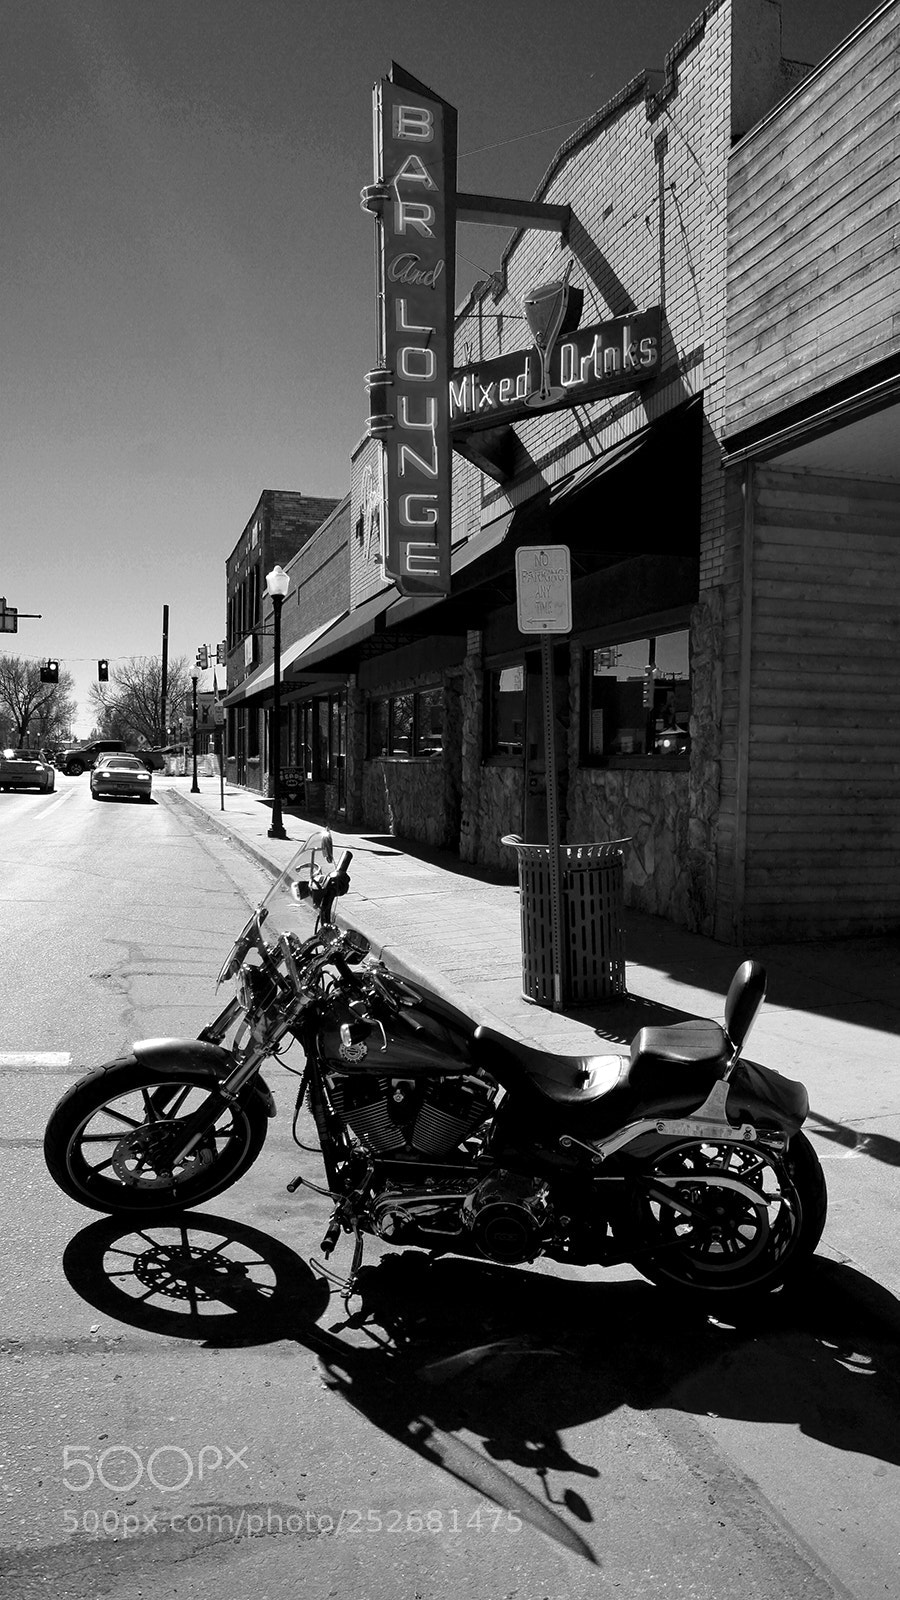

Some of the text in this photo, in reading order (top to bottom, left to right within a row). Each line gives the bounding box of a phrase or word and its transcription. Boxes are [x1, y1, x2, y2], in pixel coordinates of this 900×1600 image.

[392, 104, 440, 239] BAR
[449, 325, 657, 419] Mixed Drinks
[395, 298, 439, 576] LOUNGE
[521, 568, 566, 583] PARKING
[534, 553, 549, 567] NO
[535, 585, 552, 599] ANY
